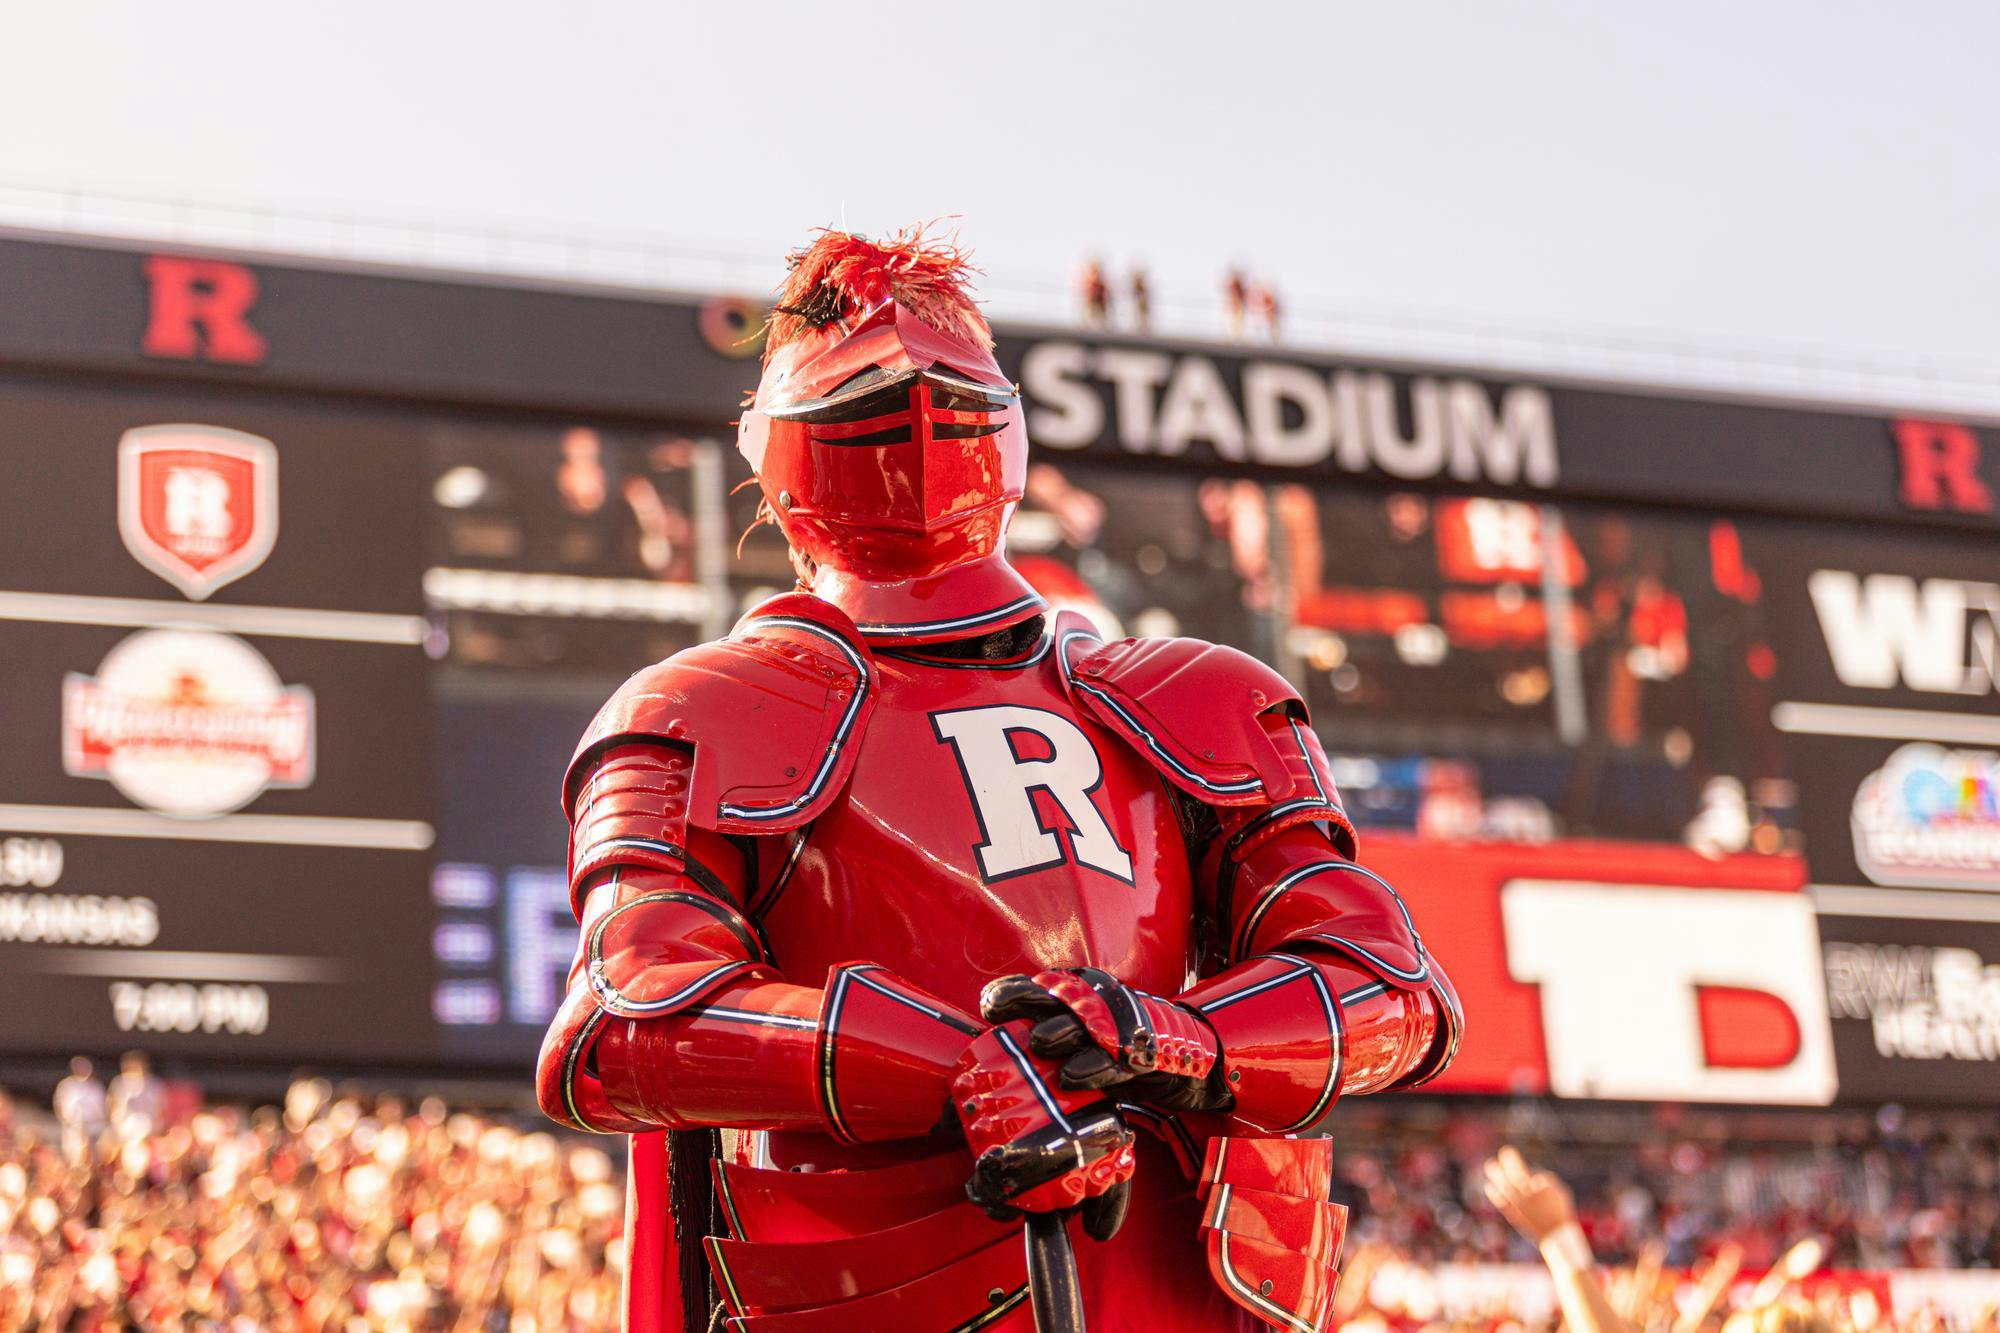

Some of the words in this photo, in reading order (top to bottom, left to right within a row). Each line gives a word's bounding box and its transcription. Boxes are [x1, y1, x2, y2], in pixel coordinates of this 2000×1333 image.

[140, 254, 269, 365] R
[1021, 340, 1560, 488] STADIUM
[1890, 416, 1995, 514] R
[927, 703, 1137, 889] R
[0, 836, 63, 888] SU
[201, 983, 269, 1036] PM
